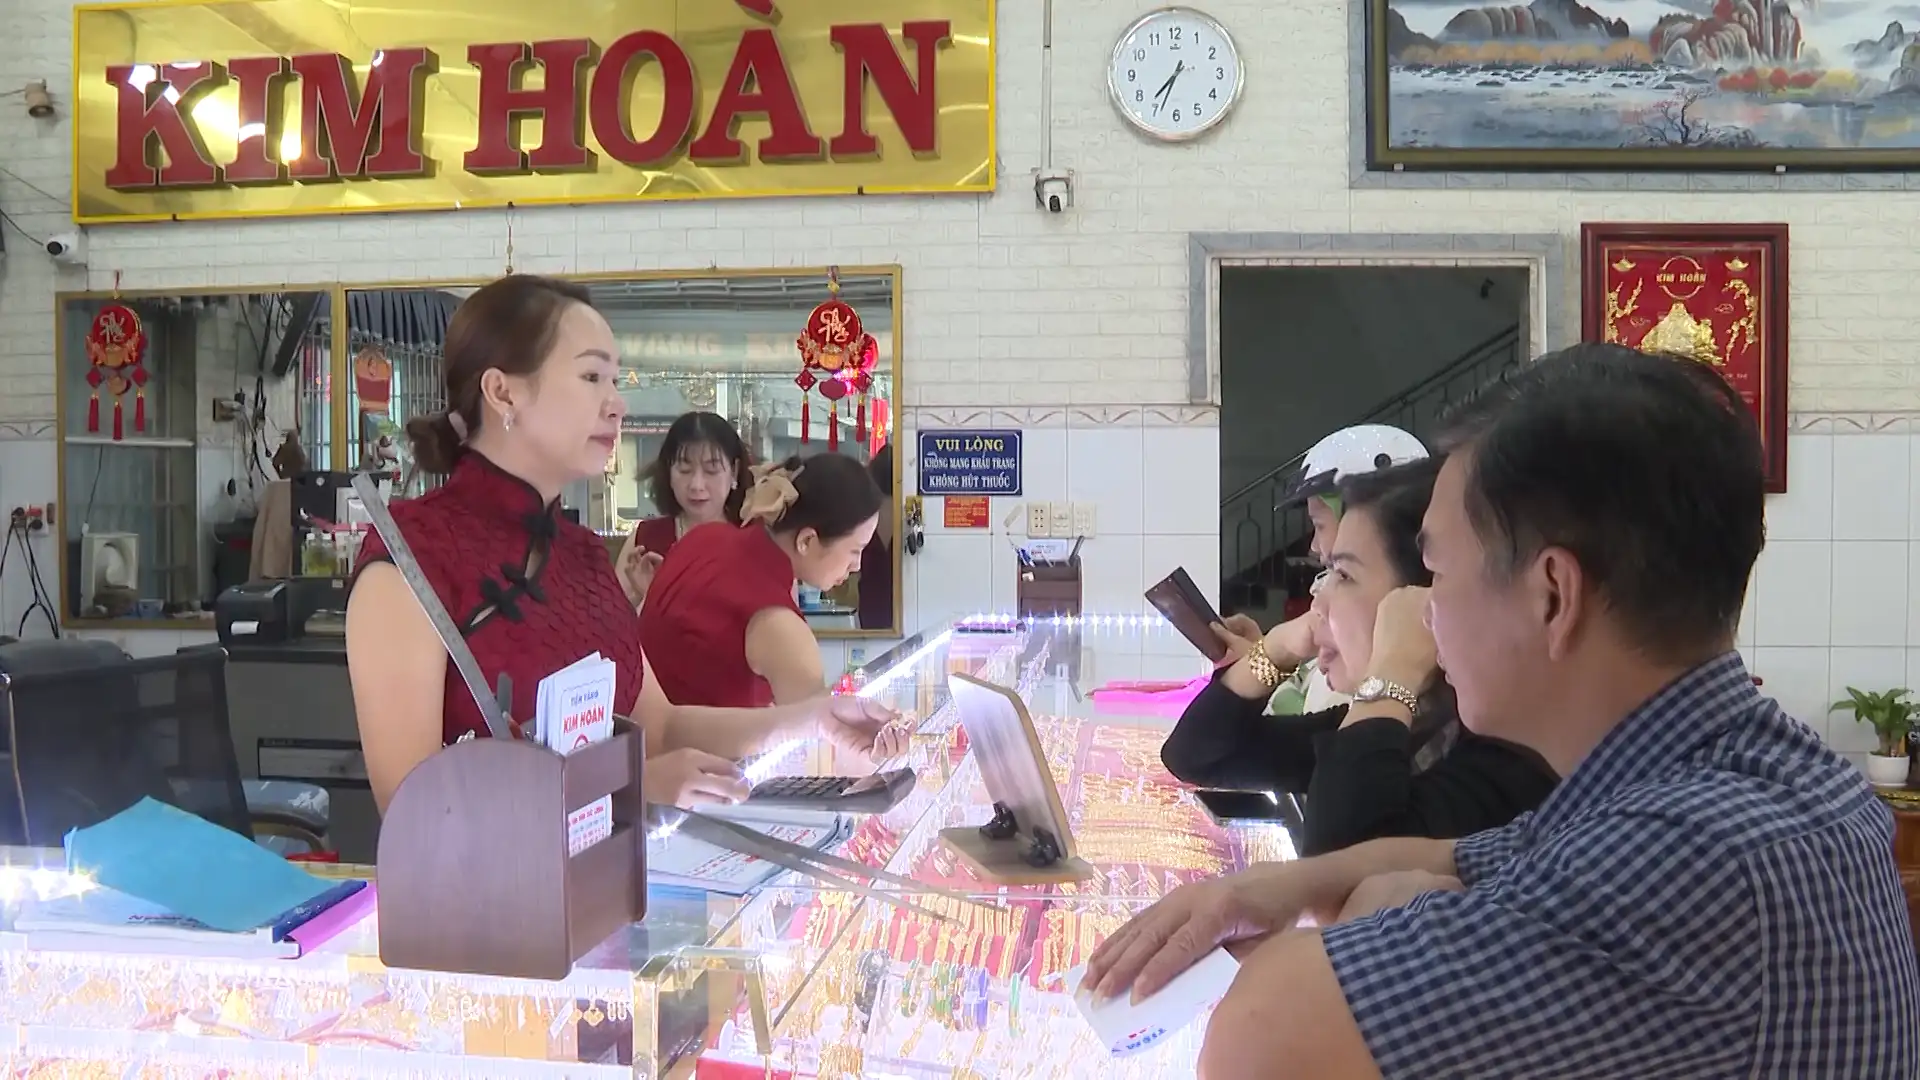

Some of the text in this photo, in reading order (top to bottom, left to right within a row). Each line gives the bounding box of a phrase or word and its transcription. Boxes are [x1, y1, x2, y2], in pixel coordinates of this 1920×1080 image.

[1149, 33, 1160, 46] 11
[1168, 27, 1182, 40] 12
[1194, 31, 1199, 44] 1
[1133, 48, 1146, 61] 10
[1208, 46, 1216, 60] 2
[1127, 69, 1136, 82] 9
[1216, 67, 1224, 80] 3
[105, 0, 953, 188] KIM HOÀN
[1135, 89, 1144, 102] 8
[1208, 87, 1217, 101] 4
[1152, 103, 1159, 117] 7
[1172, 109, 1181, 122] 6
[1193, 103, 1202, 116] 5
[1656, 273, 1675, 282] KIM
[935, 436, 1004, 452] VUI LÒNG
[949, 458, 970, 469] MANG
[992, 458, 1015, 470] TRANG
[929, 472, 1010, 488] KHÔNG HÚT THUỐC
[563, 703, 605, 734] KIM HOÀN
